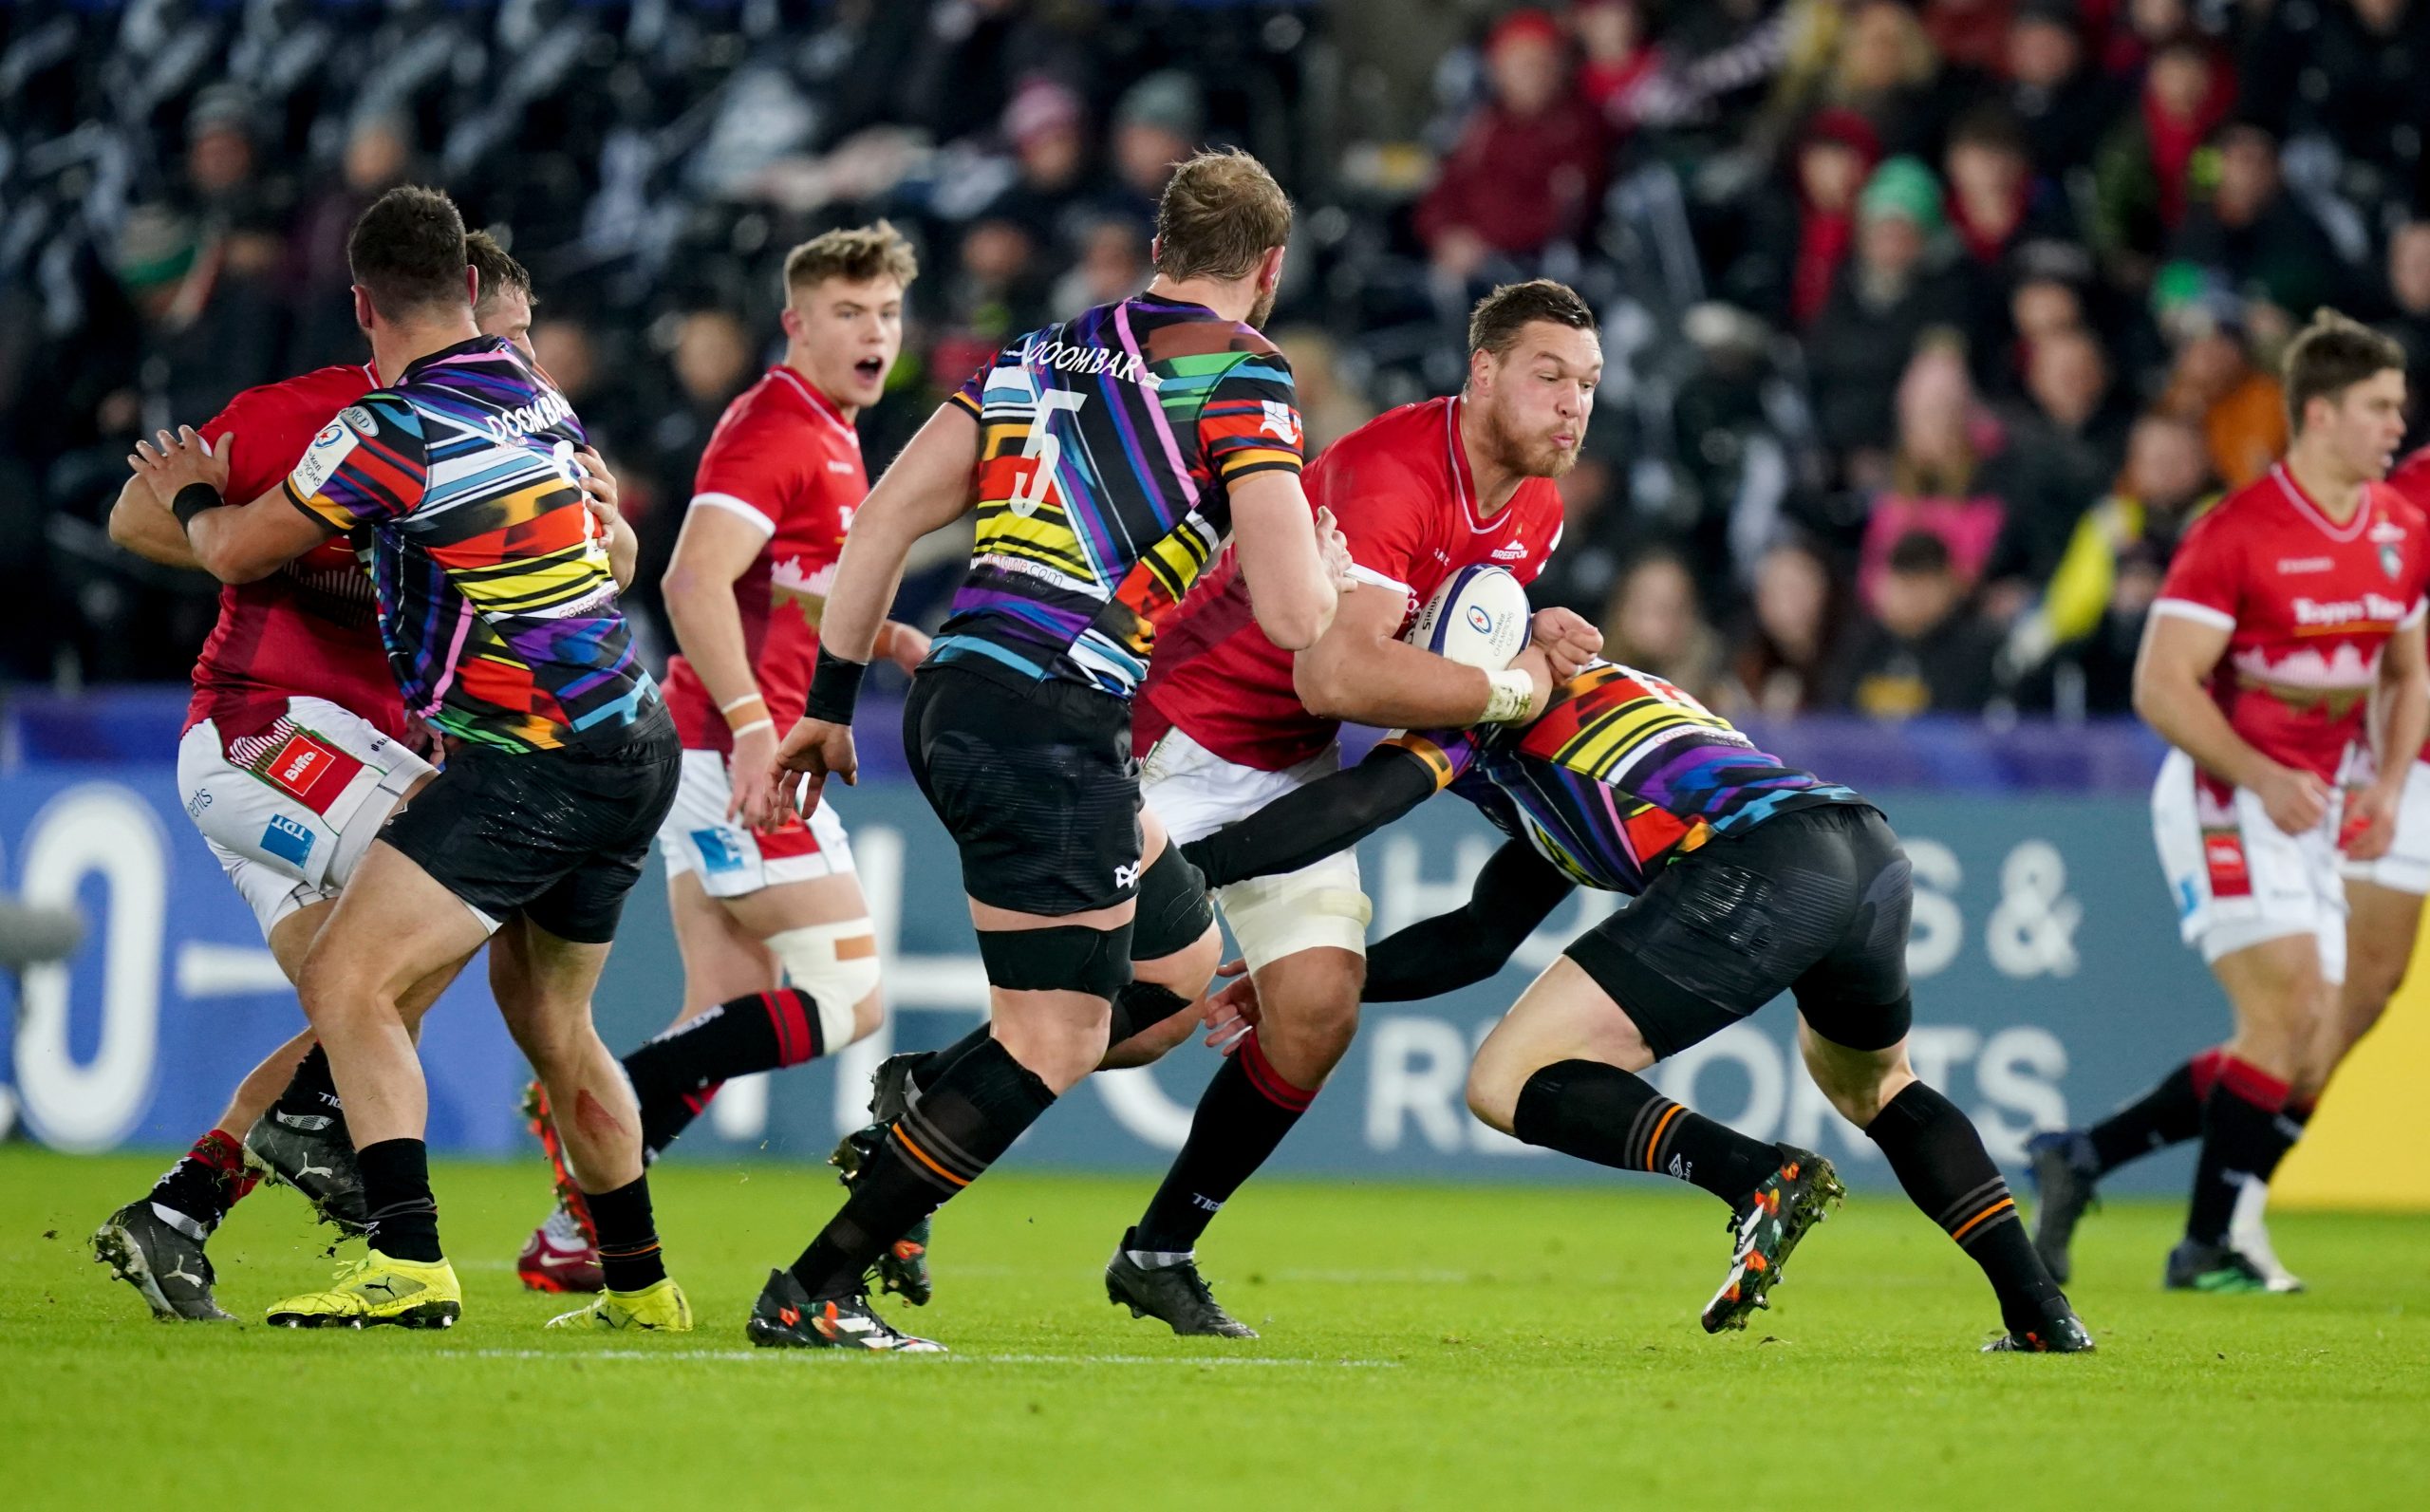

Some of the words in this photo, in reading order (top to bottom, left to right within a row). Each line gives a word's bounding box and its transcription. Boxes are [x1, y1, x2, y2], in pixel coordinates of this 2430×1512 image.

[1024, 340, 1143, 383] DOOMBAR
[1009, 388, 1088, 518] 5
[284, 751, 318, 782] Biffa
[188, 787, 213, 818] ents
[1986, 838, 2084, 980] &
